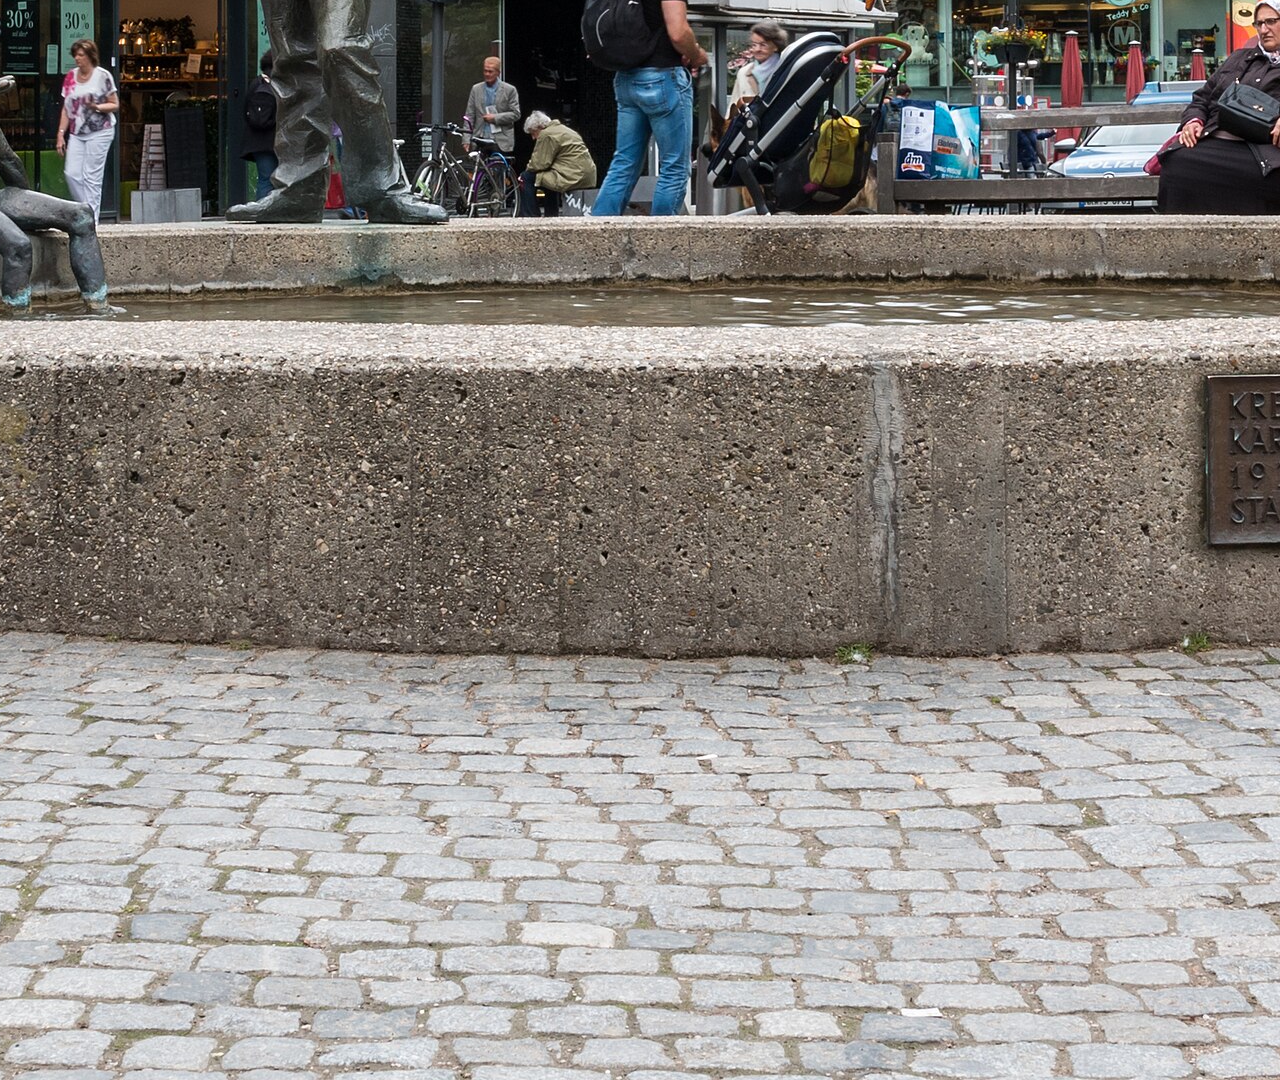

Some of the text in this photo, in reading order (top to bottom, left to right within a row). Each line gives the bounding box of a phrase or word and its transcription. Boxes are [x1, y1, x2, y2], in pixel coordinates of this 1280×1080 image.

[1106, 9, 1130, 21] Teddy
[1132, 6, 1138, 14] &
[1113, 26, 1135, 46] M
[904, 152, 922, 165] dm
[1075, 159, 1143, 170] POLIZE
